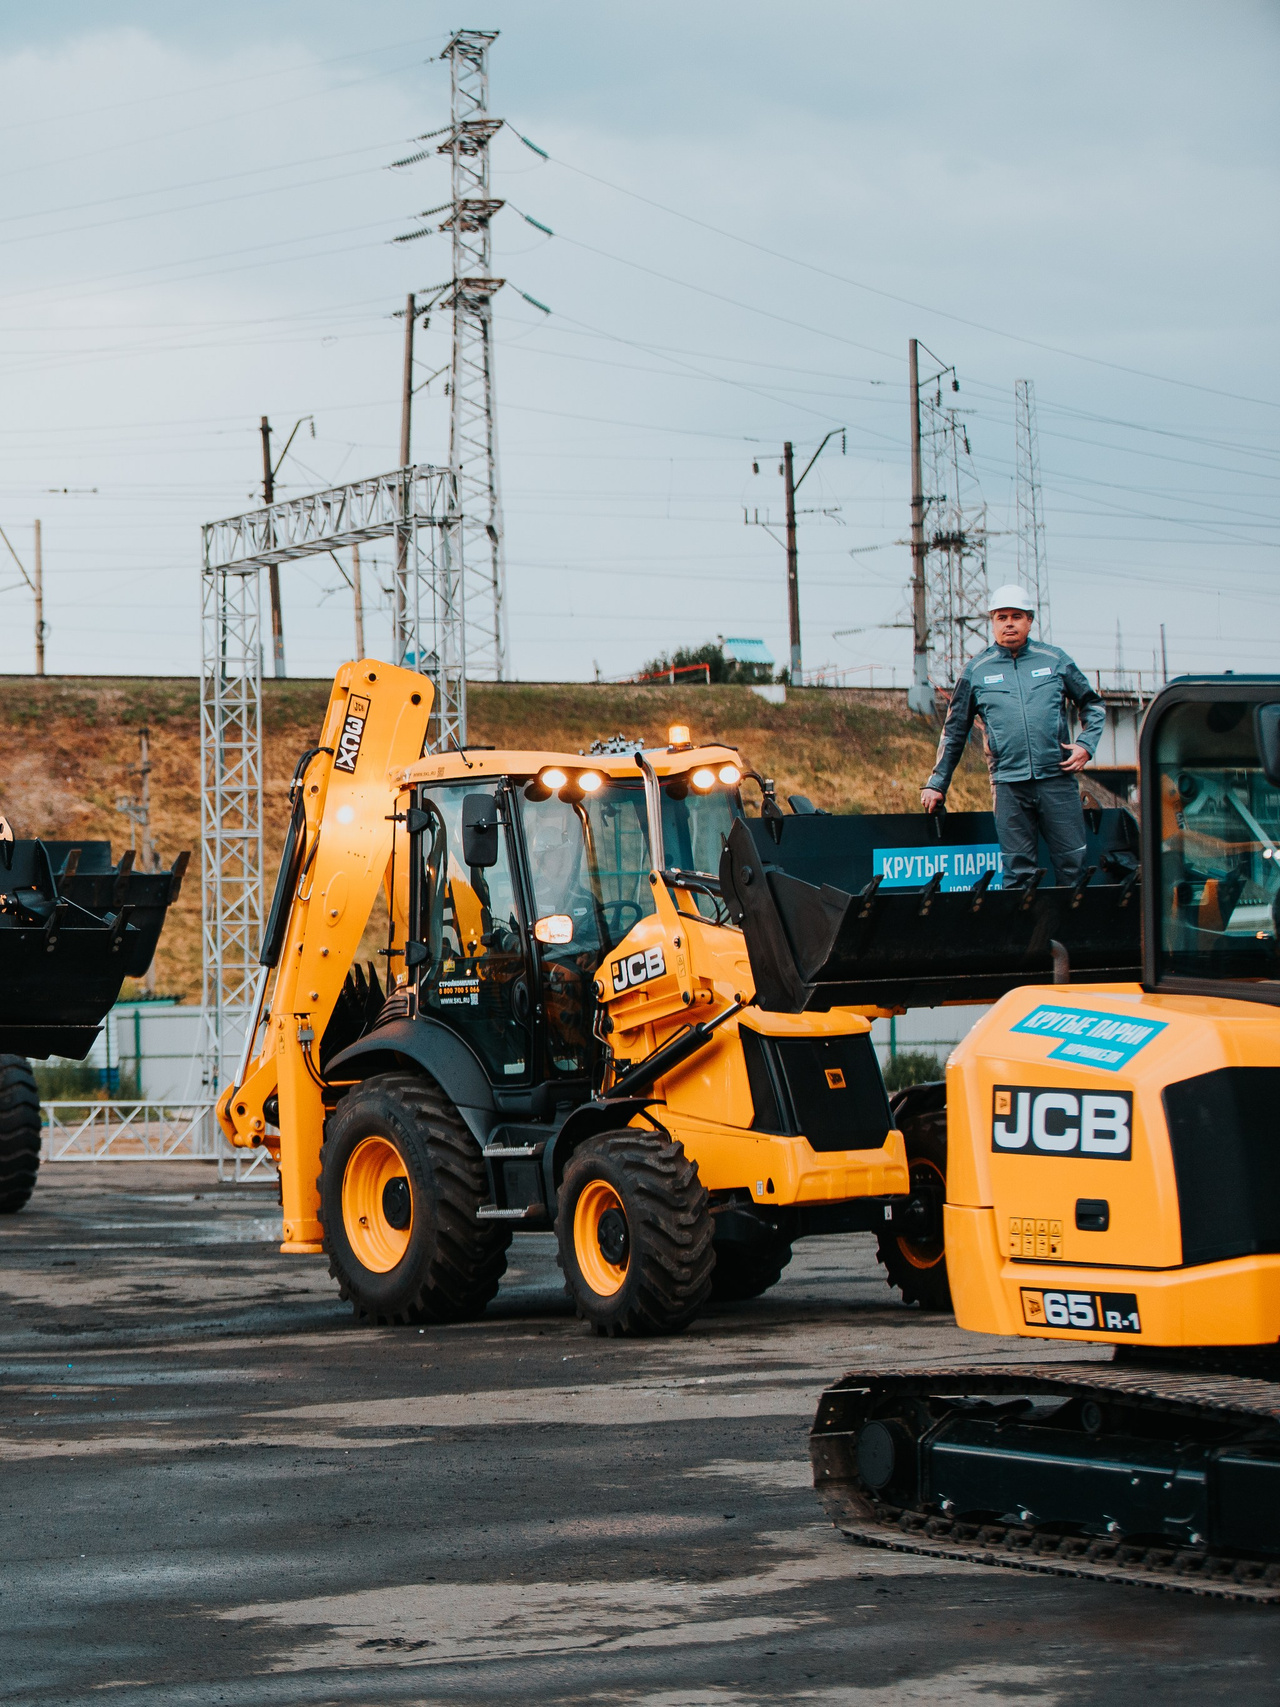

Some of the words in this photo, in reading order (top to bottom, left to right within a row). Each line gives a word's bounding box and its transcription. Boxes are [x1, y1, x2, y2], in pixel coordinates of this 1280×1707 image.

[336, 716, 364, 768] 3CX
[882, 854, 950, 879] КРУТЫЕ
[613, 946, 665, 991] JCB
[1022, 1010, 1099, 1035] КРУТЫЕ
[1085, 1019, 1155, 1046] ПАРНИ
[993, 1092, 1131, 1154] JCB
[1043, 1292, 1095, 1327] 65
[1105, 1310, 1140, 1330] R-1
